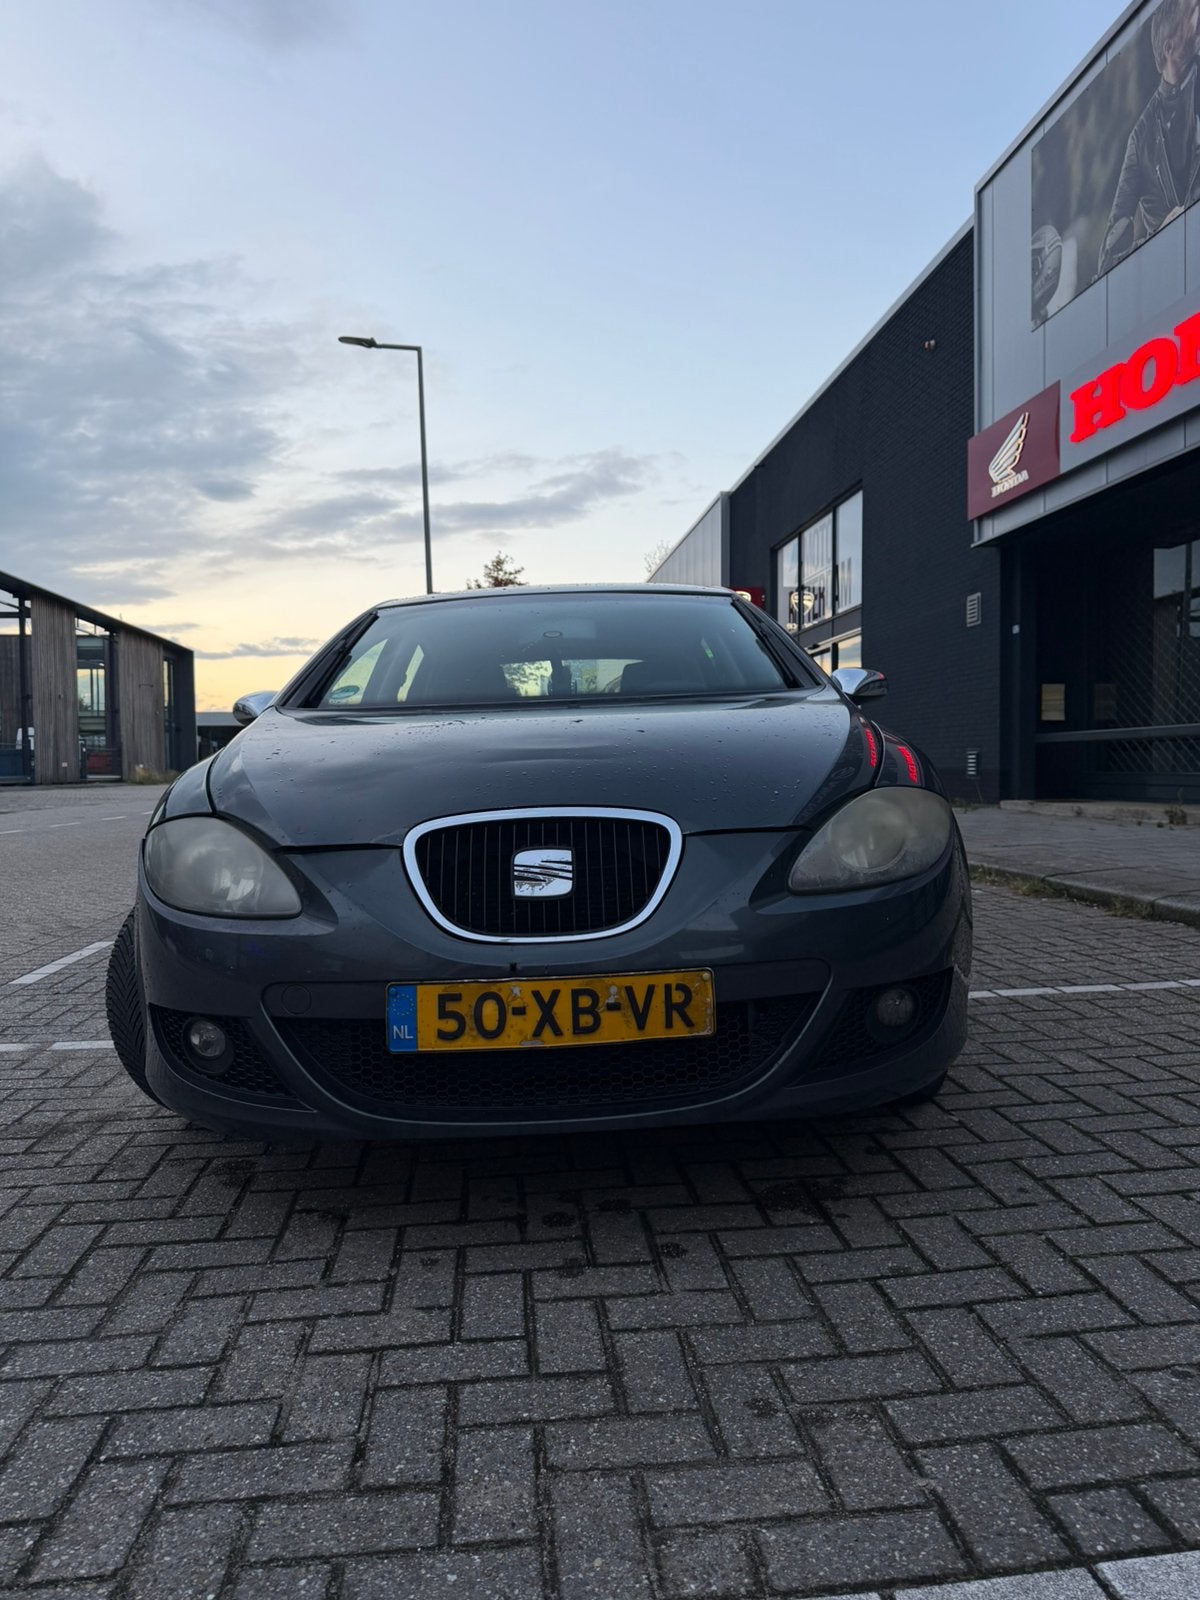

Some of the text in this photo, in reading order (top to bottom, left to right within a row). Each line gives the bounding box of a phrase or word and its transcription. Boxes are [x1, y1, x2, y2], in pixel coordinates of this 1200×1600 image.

[991, 470, 1029, 498] HONDA
[393, 983, 695, 1041] NL 50-XB-VR
